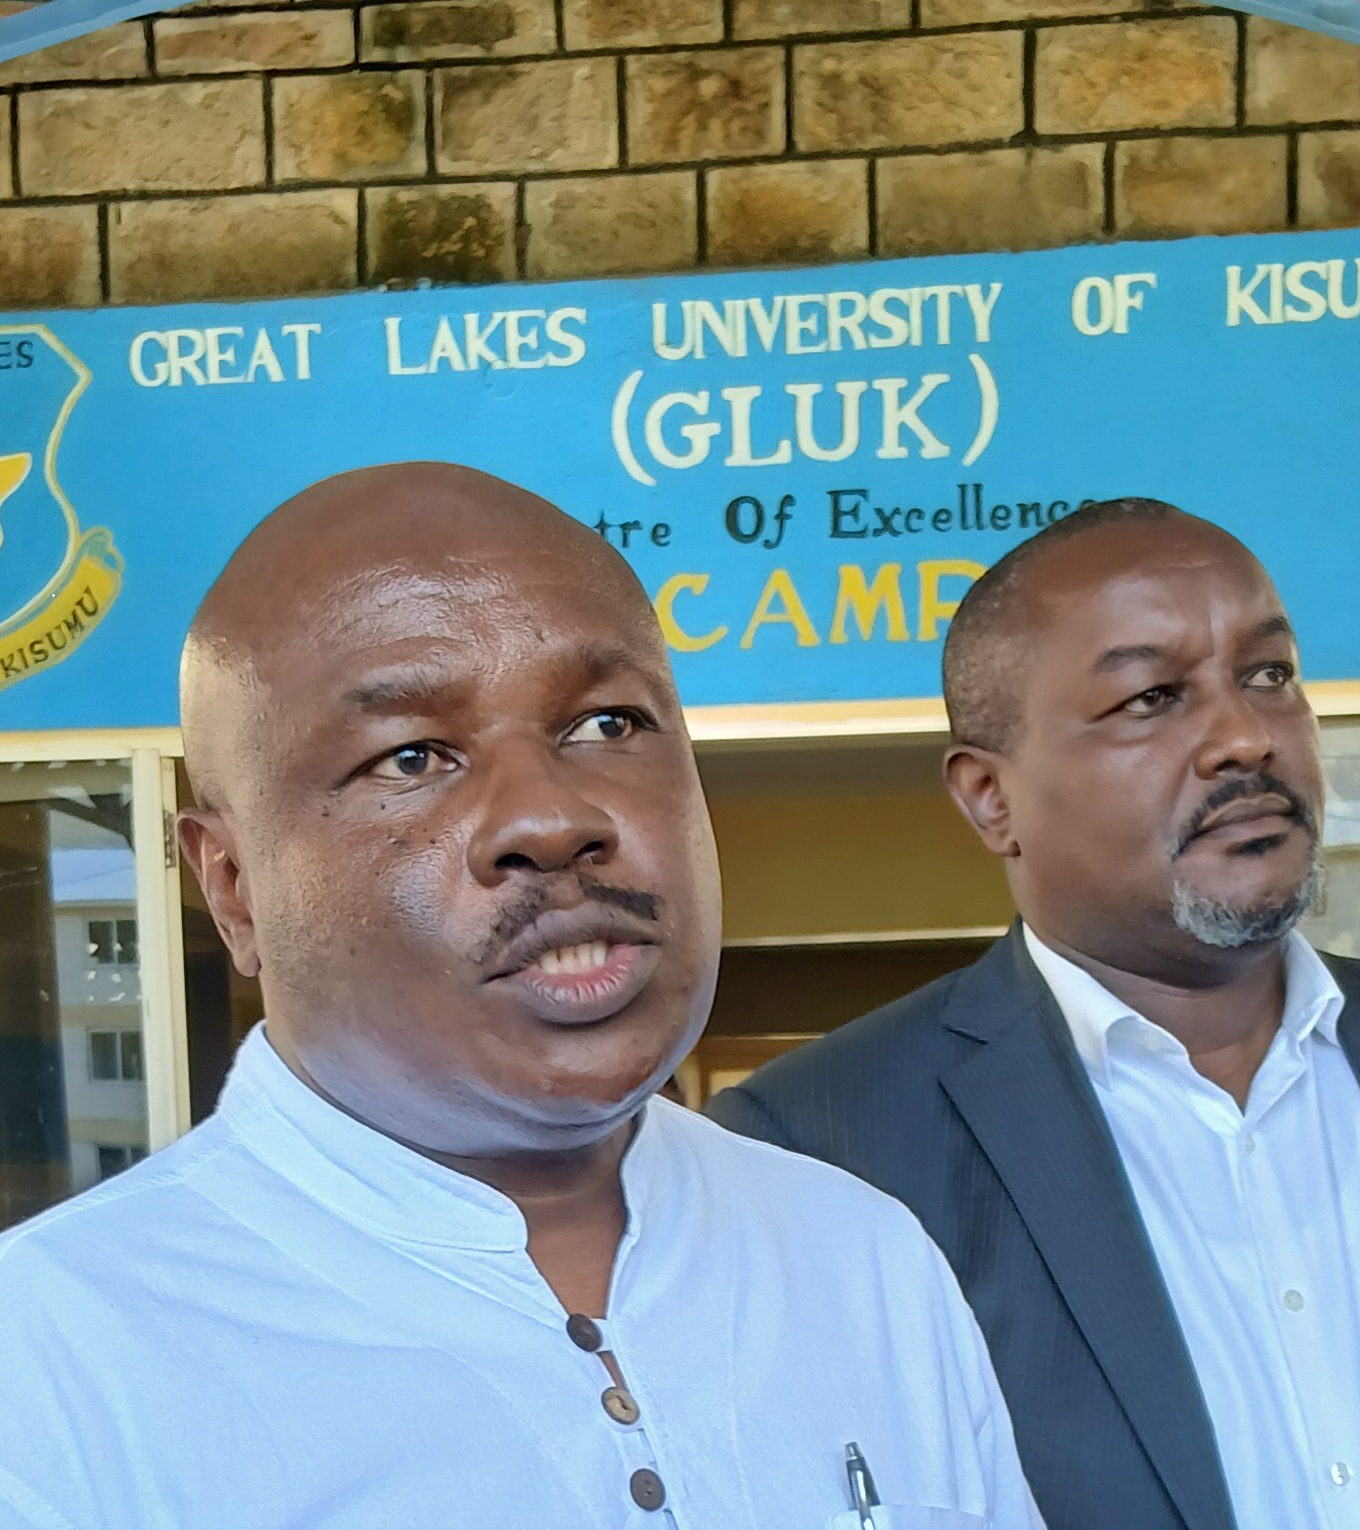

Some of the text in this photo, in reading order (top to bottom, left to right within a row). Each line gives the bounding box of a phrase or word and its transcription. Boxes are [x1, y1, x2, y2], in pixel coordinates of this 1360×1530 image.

[128, 323, 322, 388] GREAT
[384, 307, 587, 376] LAKES
[651, 283, 1003, 362] UNIVERSITY
[1071, 272, 1157, 336] OF
[611, 353, 999, 486] (GLUK)
[593, 483, 1096, 549] tre Of Excellenc
[0, 586, 100, 679] KISUMU
[654, 557, 991, 652] CAMP
